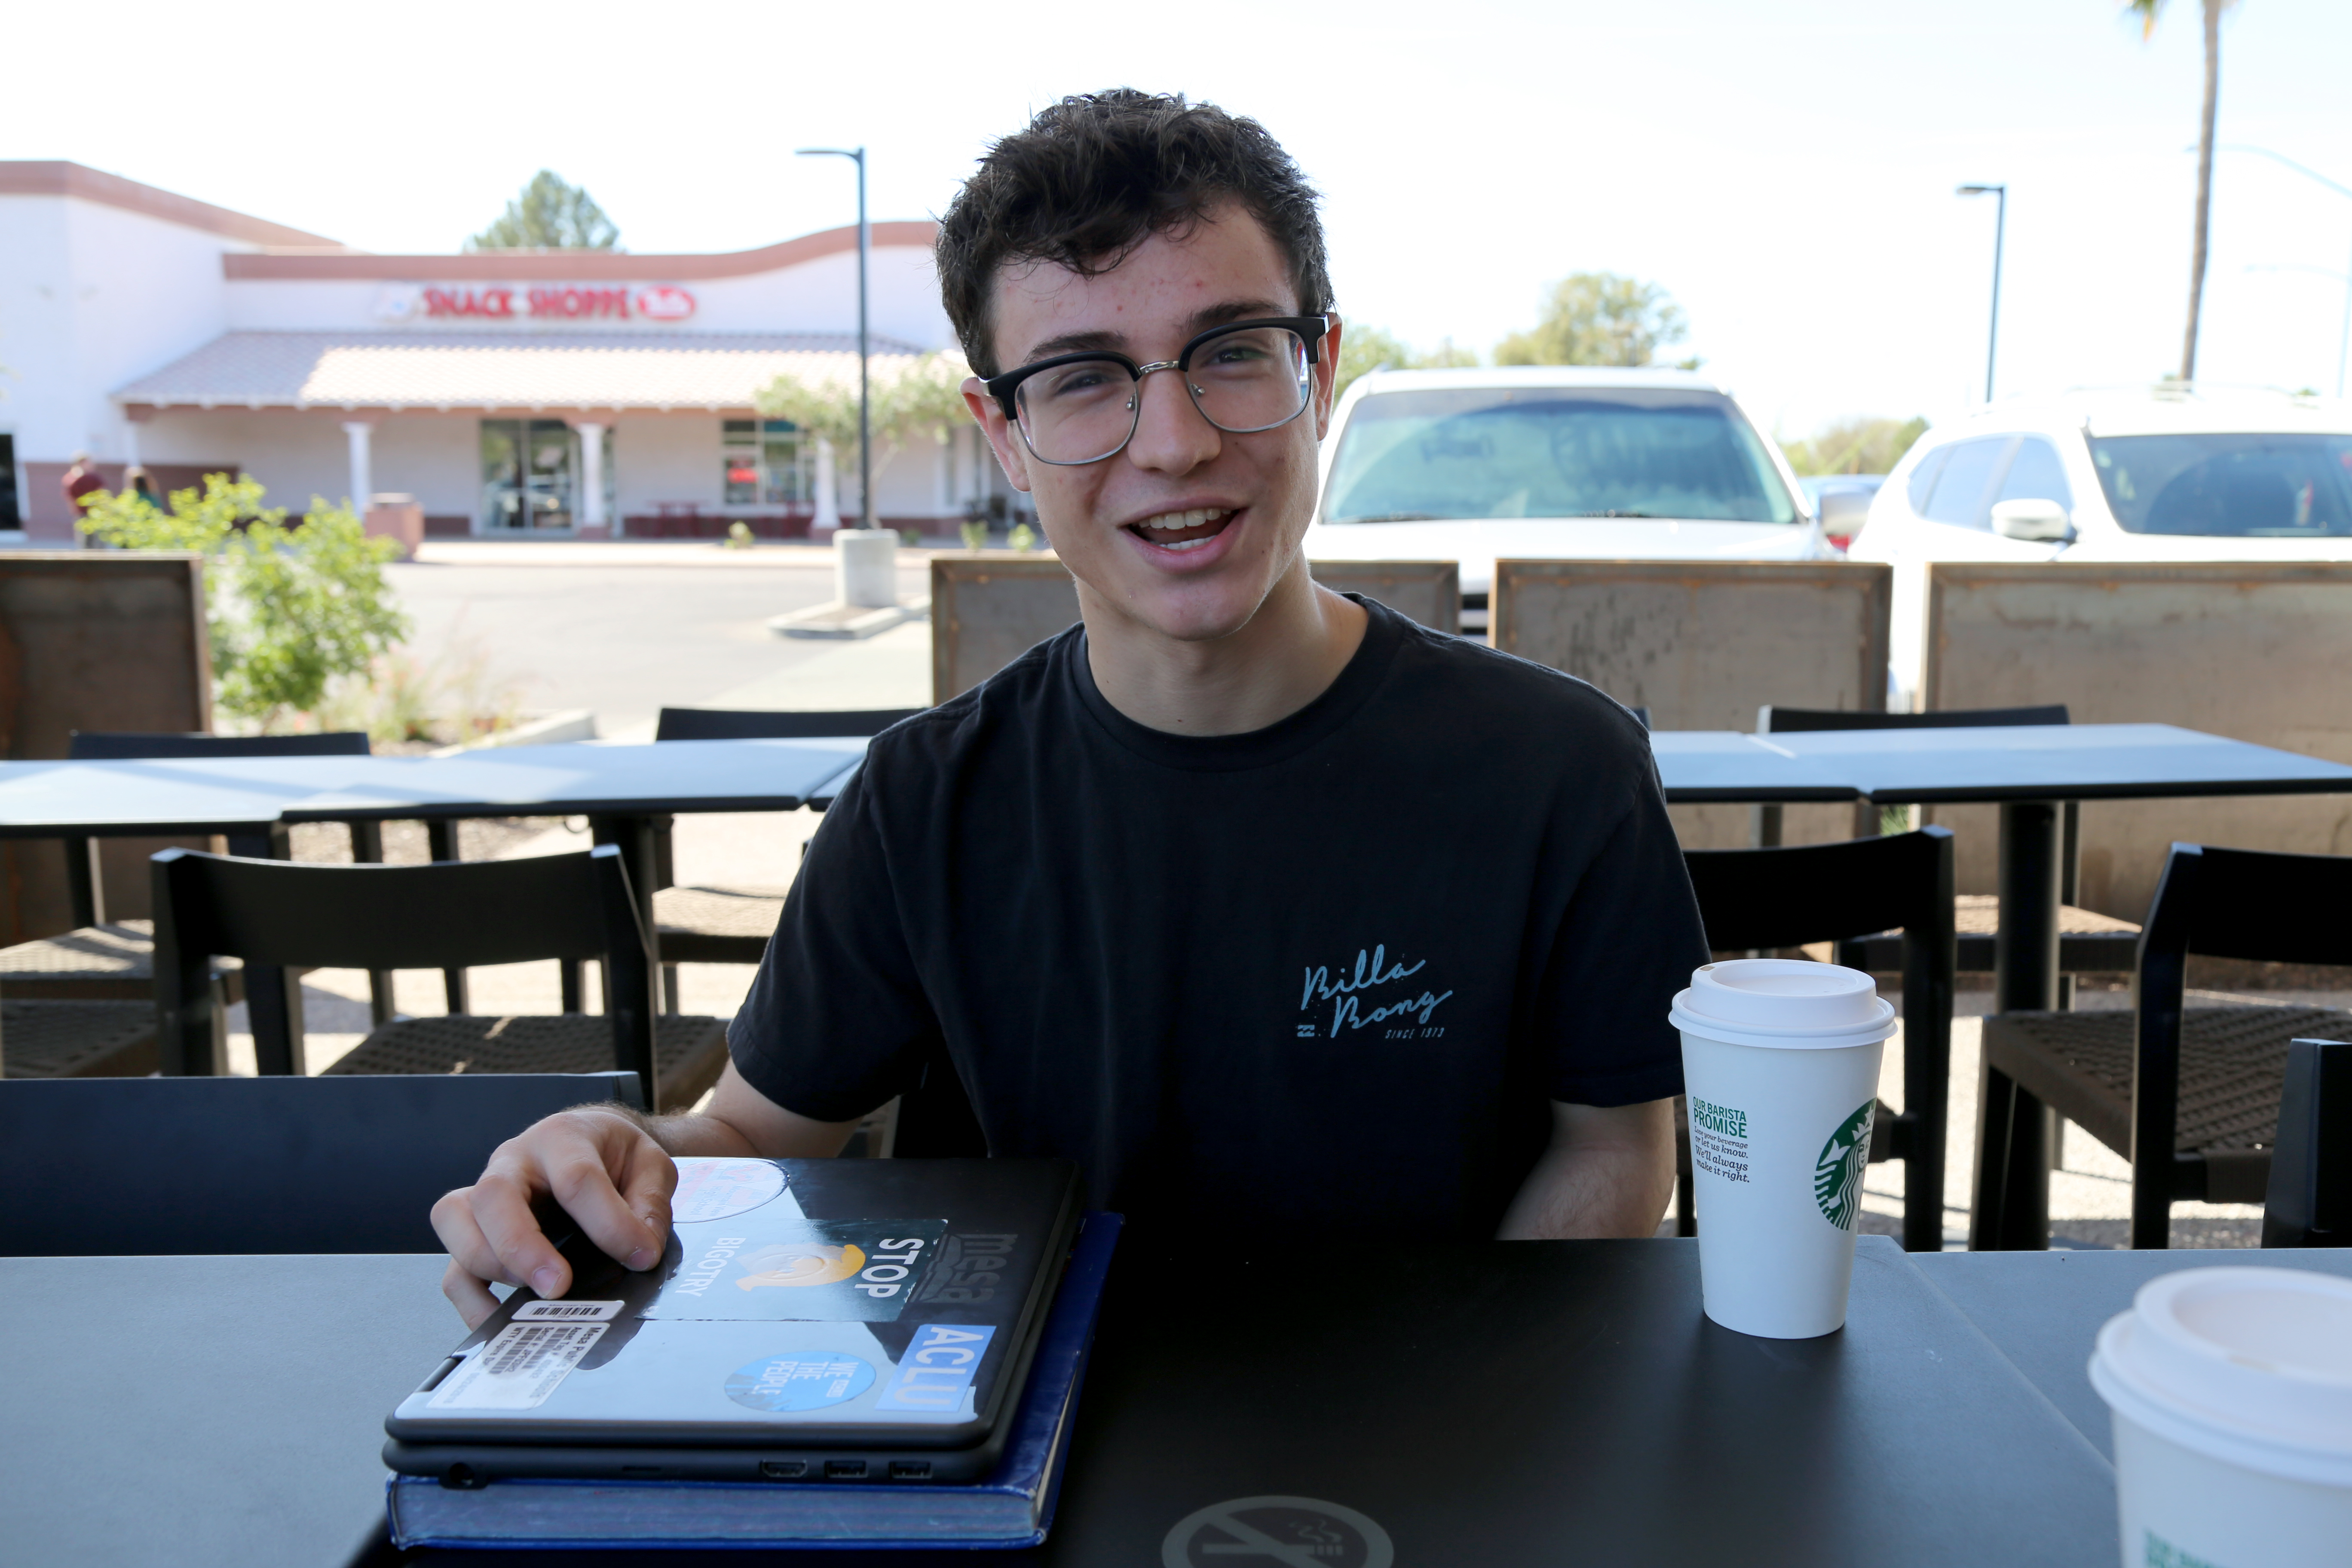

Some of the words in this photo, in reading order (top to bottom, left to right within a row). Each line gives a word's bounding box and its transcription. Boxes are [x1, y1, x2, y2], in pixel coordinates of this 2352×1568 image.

[423, 287, 513, 318] SNACK
[1301, 944, 1426, 1010] Billa
[1330, 990, 1452, 1038] Bong
[1385, 1029, 1415, 1039] SINCE
[1421, 1027, 1445, 1038] 1973
[1693, 1096, 1706, 1112] OUR
[1707, 1102, 1746, 1122] BARISTA
[1694, 1107, 1747, 1139] PROMISE
[1694, 1126, 1703, 1136] Love
[1704, 1132, 1717, 1141] your
[1717, 1135, 1748, 1149] beverage
[1701, 1137, 1709, 1148] let
[1710, 1143, 1720, 1152] us
[1721, 1144, 1748, 1158] know.
[1695, 1145, 1711, 1161] We'll
[1712, 1155, 1748, 1171] always
[1696, 1158, 1712, 1173] make
[1713, 1166, 1721, 1175] it
[1722, 1170, 1749, 1183] right.
[703, 1185, 723, 1198] High
[717, 1185, 742, 1205] Mountain
[689, 1198, 713, 1216] School
[709, 1205, 726, 1217] View
[674, 1237, 747, 1297] BIGOTRY
[854, 1238, 925, 1298] STOP
[923, 1234, 1018, 1303] mesa
[508, 1326, 525, 1338] WTY
[534, 1327, 554, 1341] Serial
[563, 1327, 582, 1340] Asset
[577, 1327, 602, 1344] Mesa
[490, 1340, 512, 1356] Expire
[552, 1341, 570, 1351] Tag
[556, 1346, 585, 1367] Public
[791, 1361, 830, 1381] THE
[824, 1361, 859, 1378] WE
[893, 1326, 984, 1405] ACLU
[751, 1360, 799, 1396] PEOPLE
